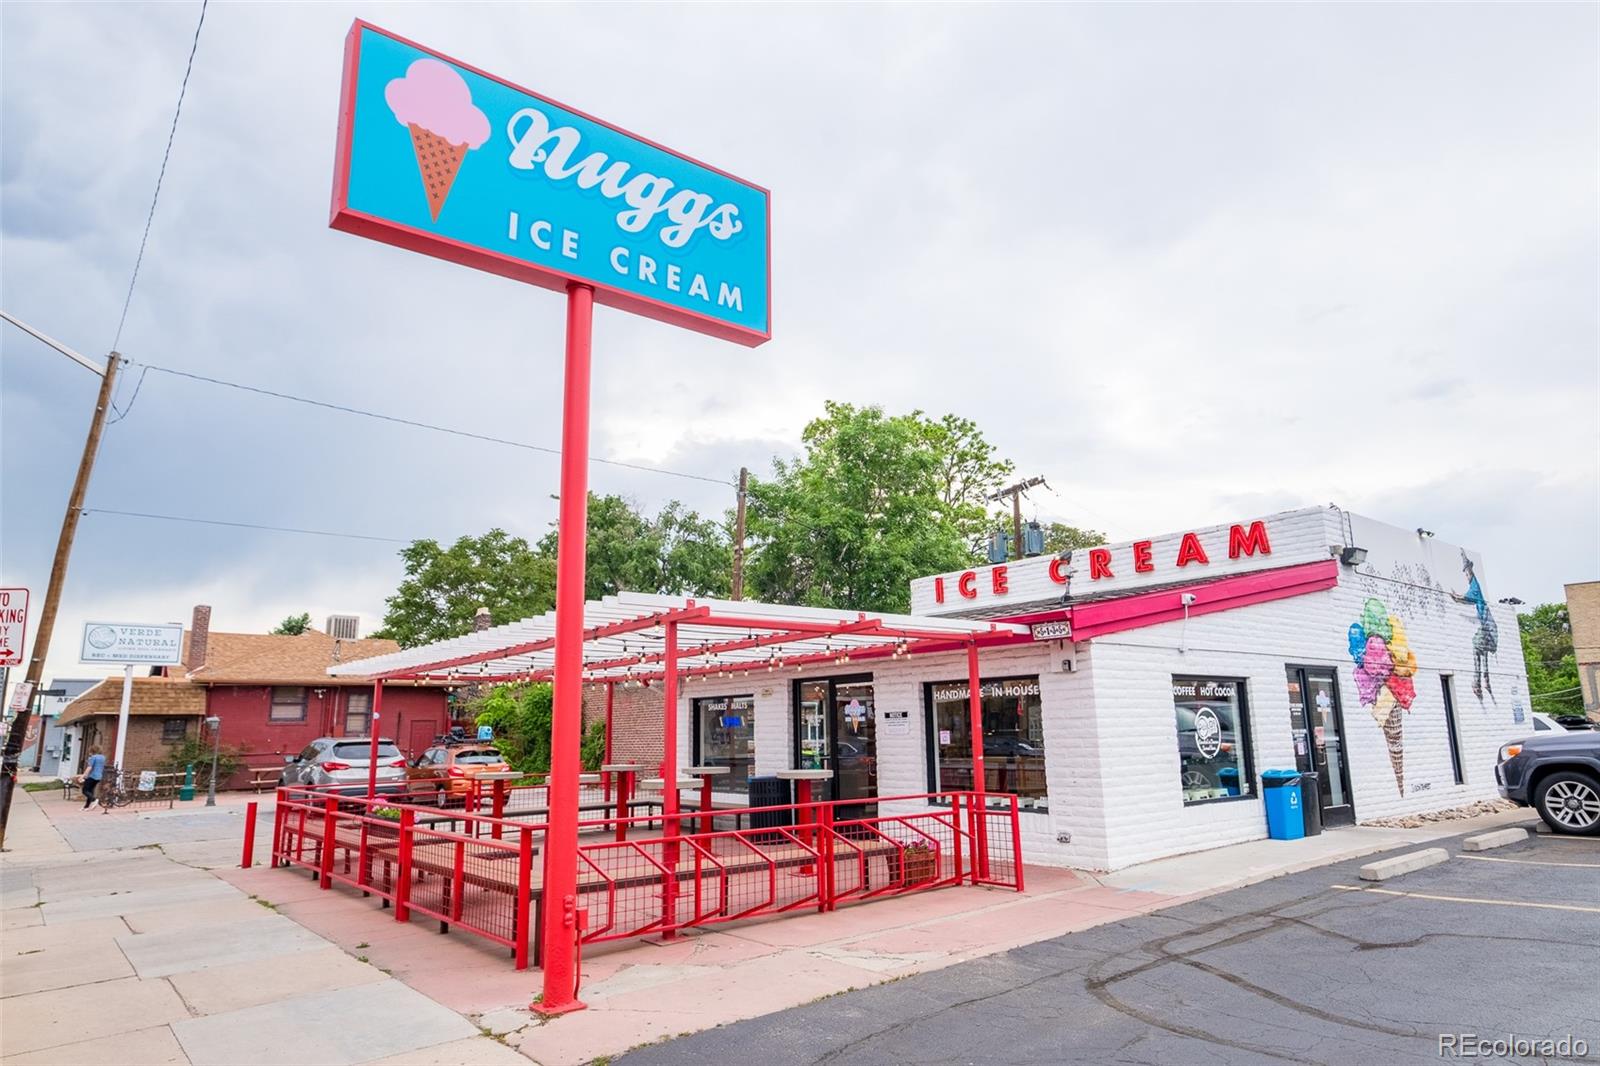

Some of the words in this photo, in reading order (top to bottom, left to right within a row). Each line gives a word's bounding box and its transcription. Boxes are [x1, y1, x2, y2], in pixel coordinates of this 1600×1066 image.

[508, 212, 580, 260] ICE
[610, 247, 743, 312] CREAM
[935, 566, 1009, 604] ICE
[1049, 520, 1272, 585] CREAM
[120, 628, 162, 637] VERDE
[118, 638, 177, 647] NATURAL
[934, 688, 984, 700] HANDMAE
[991, 687, 1003, 697] IN
[1005, 685, 1040, 696] HOUSE
[1173, 686, 1196, 696] COFFEE
[1200, 687, 1213, 696] HOT
[1214, 687, 1236, 697] COCOA
